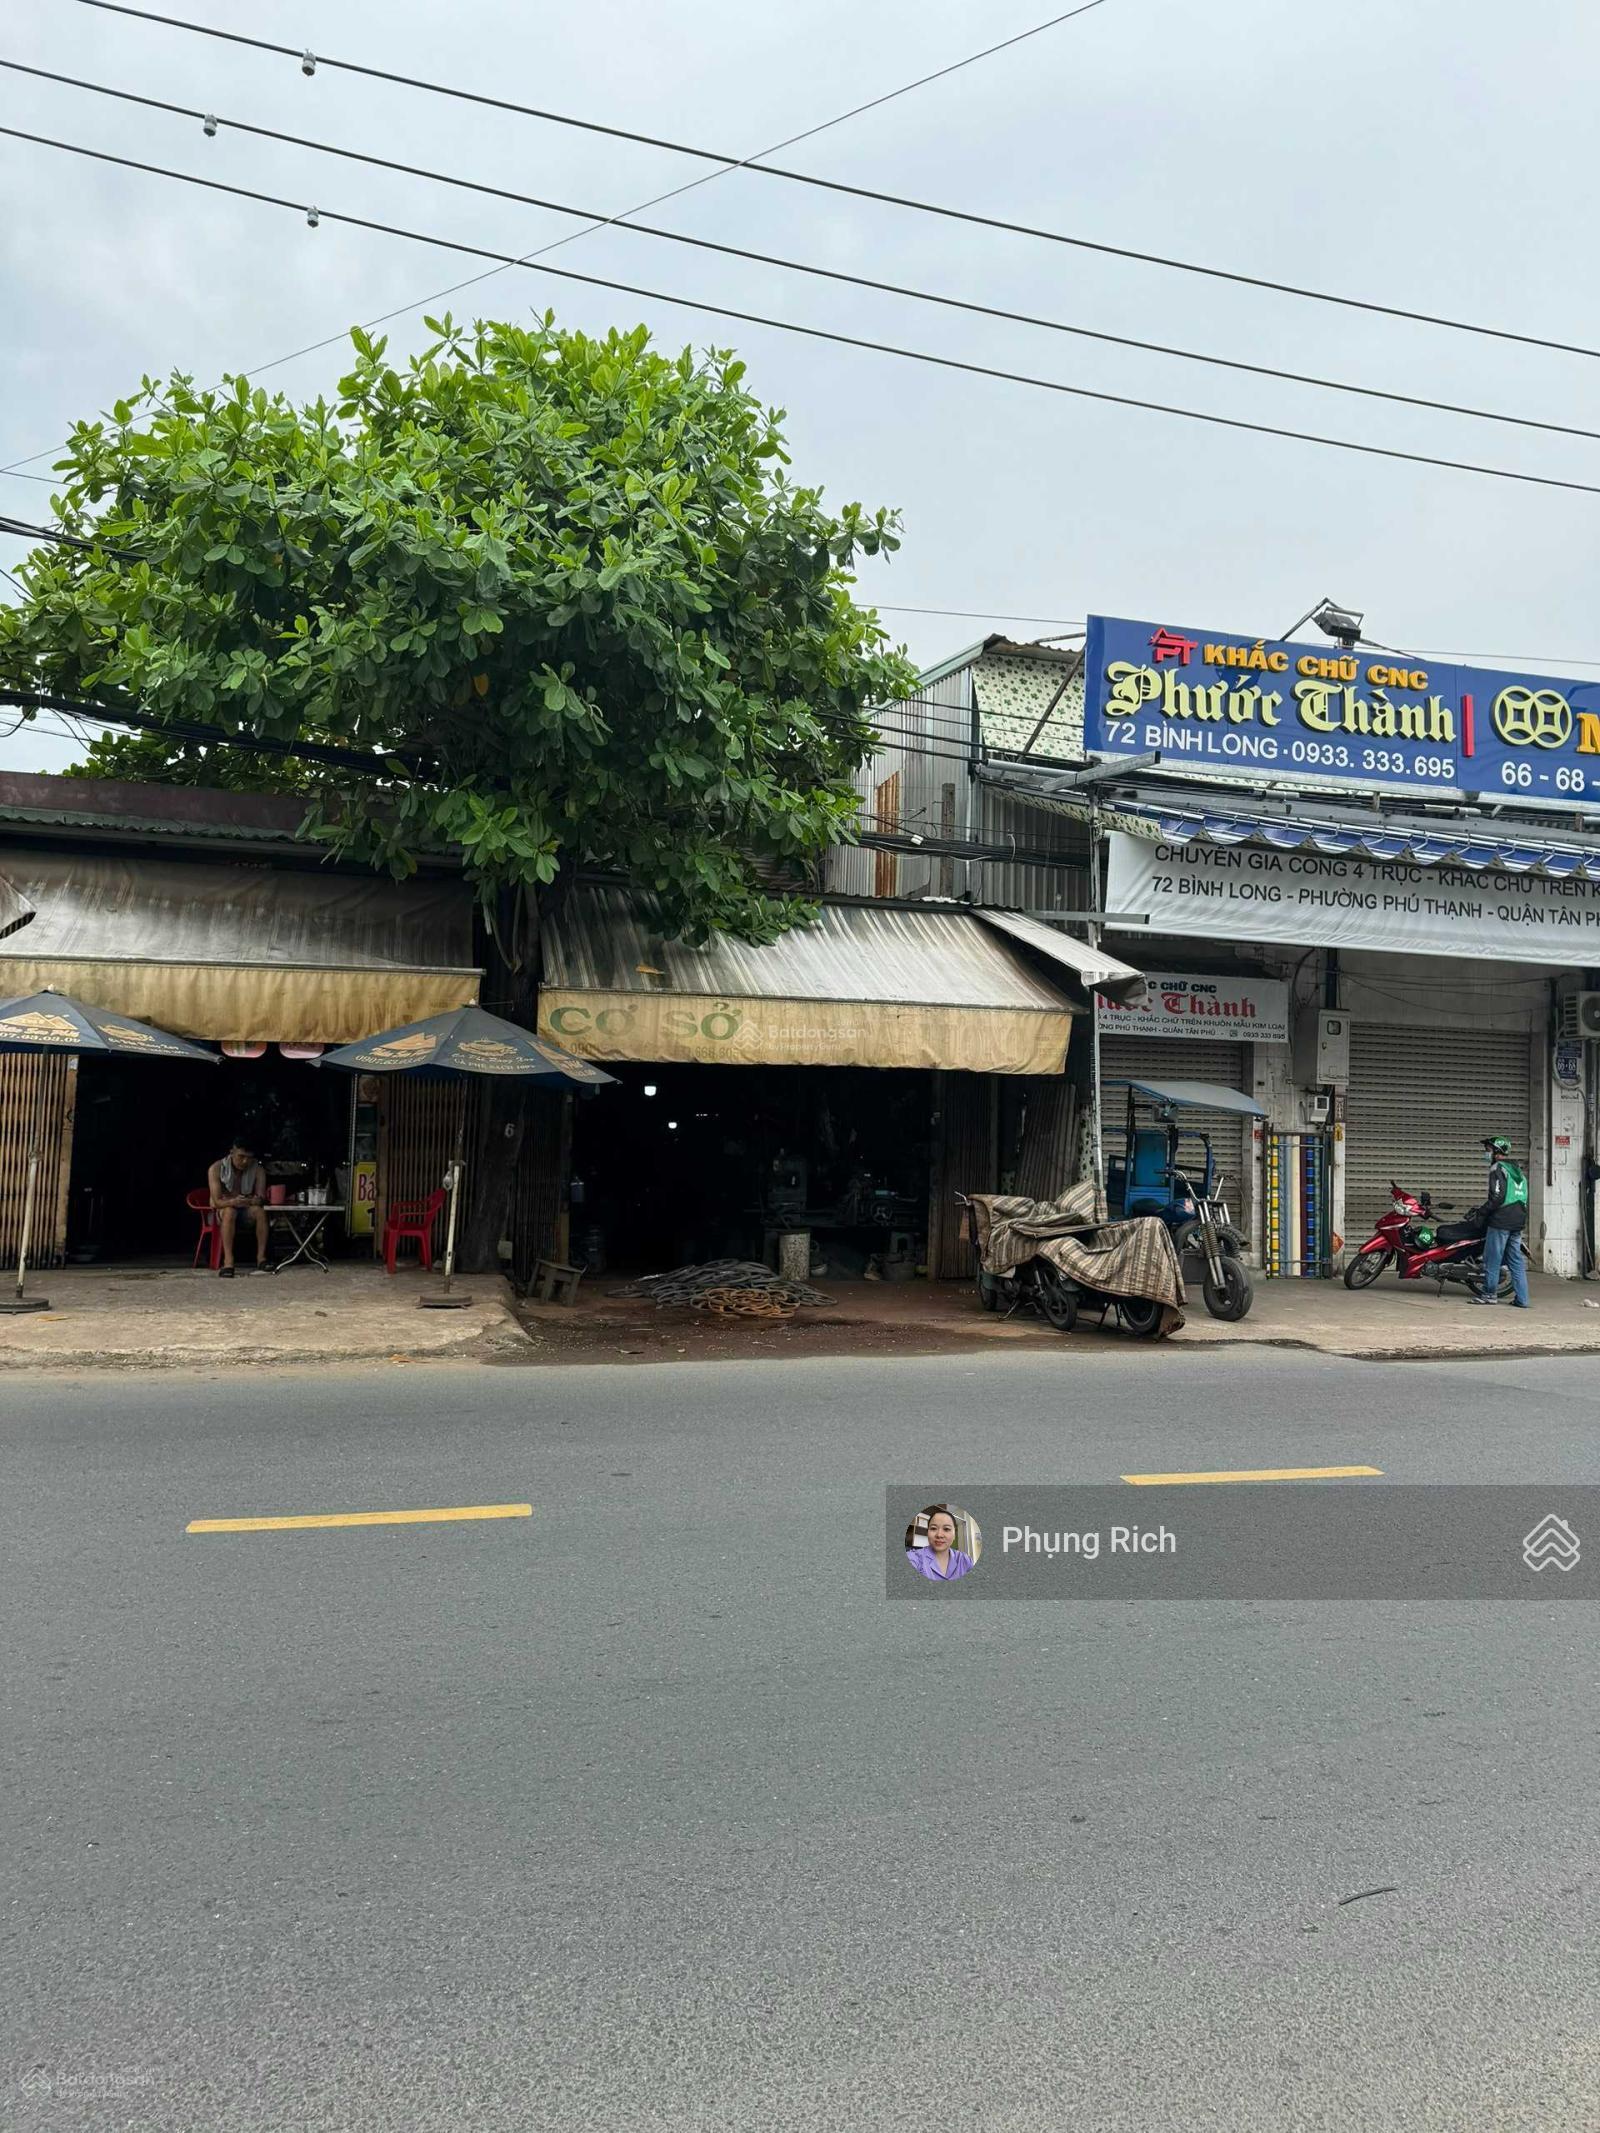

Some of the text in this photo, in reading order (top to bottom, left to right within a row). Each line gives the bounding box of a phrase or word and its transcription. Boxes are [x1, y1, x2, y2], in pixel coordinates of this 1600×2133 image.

[1203, 639, 1289, 672] KHẮC
[1297, 655, 1360, 681] CHỮ
[1367, 664, 1429, 691] CNC
[1105, 661, 1457, 743] Phước Thành
[1105, 720, 1136, 745] 72
[1145, 720, 1202, 752] BÌNH
[1501, 760, 1532, 788] 66
[1556, 767, 1585, 793] 68
[1248, 853, 1283, 872] GIA
[1353, 864, 1364, 879] 4
[1370, 863, 1422, 886] TRỤC
[1152, 876, 1173, 893] 72
[1179, 875, 1223, 898] BÌNH
[1229, 882, 1281, 902] LONG
[1298, 887, 1377, 910] PHƯỜNG
[1383, 894, 1420, 913] PHÚ
[1424, 898, 1482, 921] THẠNH
[1498, 904, 1545, 927] QUẬN
[1549, 906, 1582, 927] TÂN
[1160, 991, 1257, 1019] Thành
[1191, 984, 1217, 994] CNC
